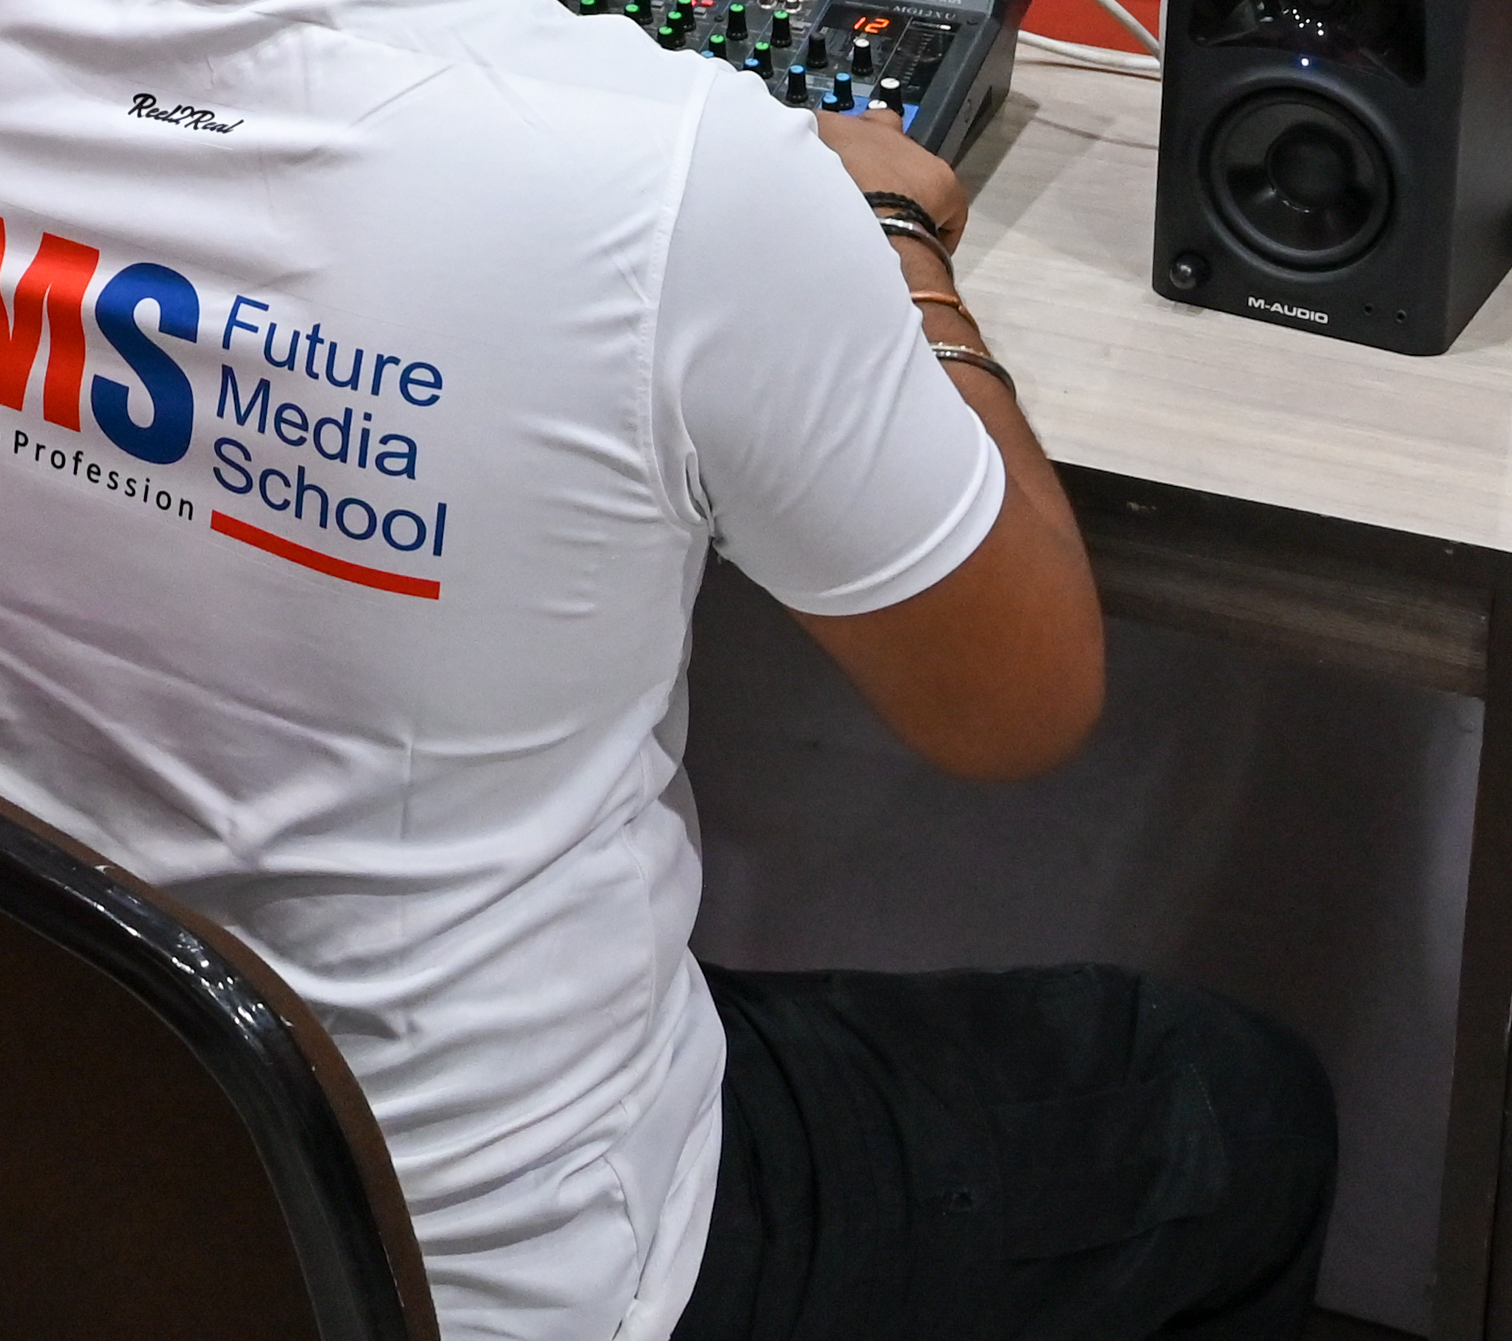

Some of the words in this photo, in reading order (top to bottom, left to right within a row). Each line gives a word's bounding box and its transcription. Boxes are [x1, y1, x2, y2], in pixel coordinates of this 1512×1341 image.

[854, 16, 891, 34] 12
[127, 93, 245, 134] Reel2Real
[221, 294, 446, 408] Future
[1247, 296, 1329, 324] M-AUDIO
[216, 365, 420, 481] Media
[13, 430, 195, 522] Profession
[212, 437, 449, 558] School
